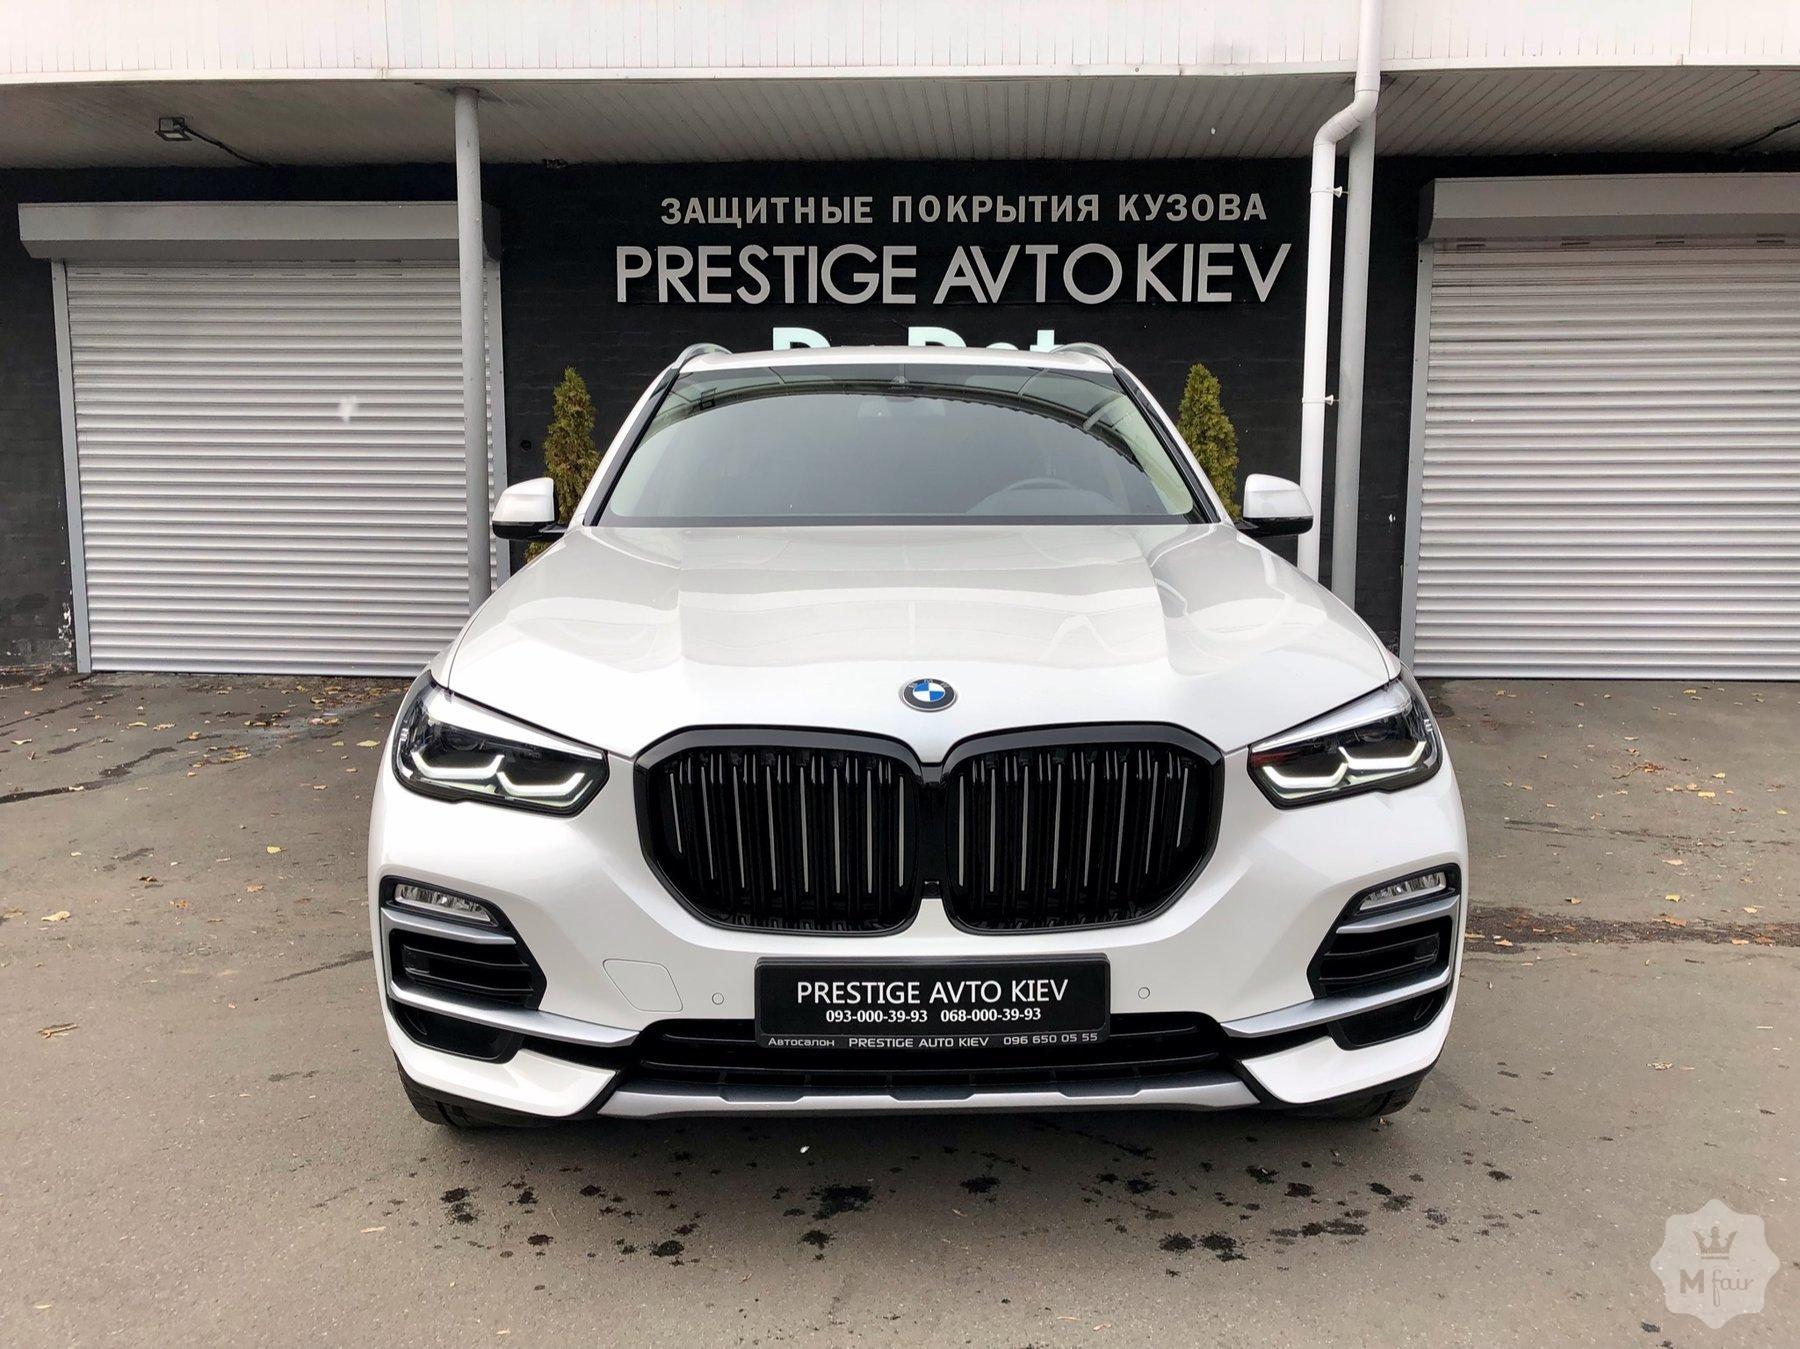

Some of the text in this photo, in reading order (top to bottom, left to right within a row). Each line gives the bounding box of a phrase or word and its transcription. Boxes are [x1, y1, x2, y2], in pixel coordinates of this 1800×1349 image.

[661, 193, 1267, 228] ЗАЩИТНЫЕ ПОКРЫТИЯ КУЗОВА
[617, 243, 1292, 304] PRESTIGE AVTO KIEV
[796, 978, 1070, 1005] PRESTIGE AVTO KIEV
[825, 1007, 1043, 1024] 093-000-39-93 068-000-39-93
[768, 1033, 1099, 1048] Автосалон PRESTIGE AUTO KIEV 096 650 05 55
